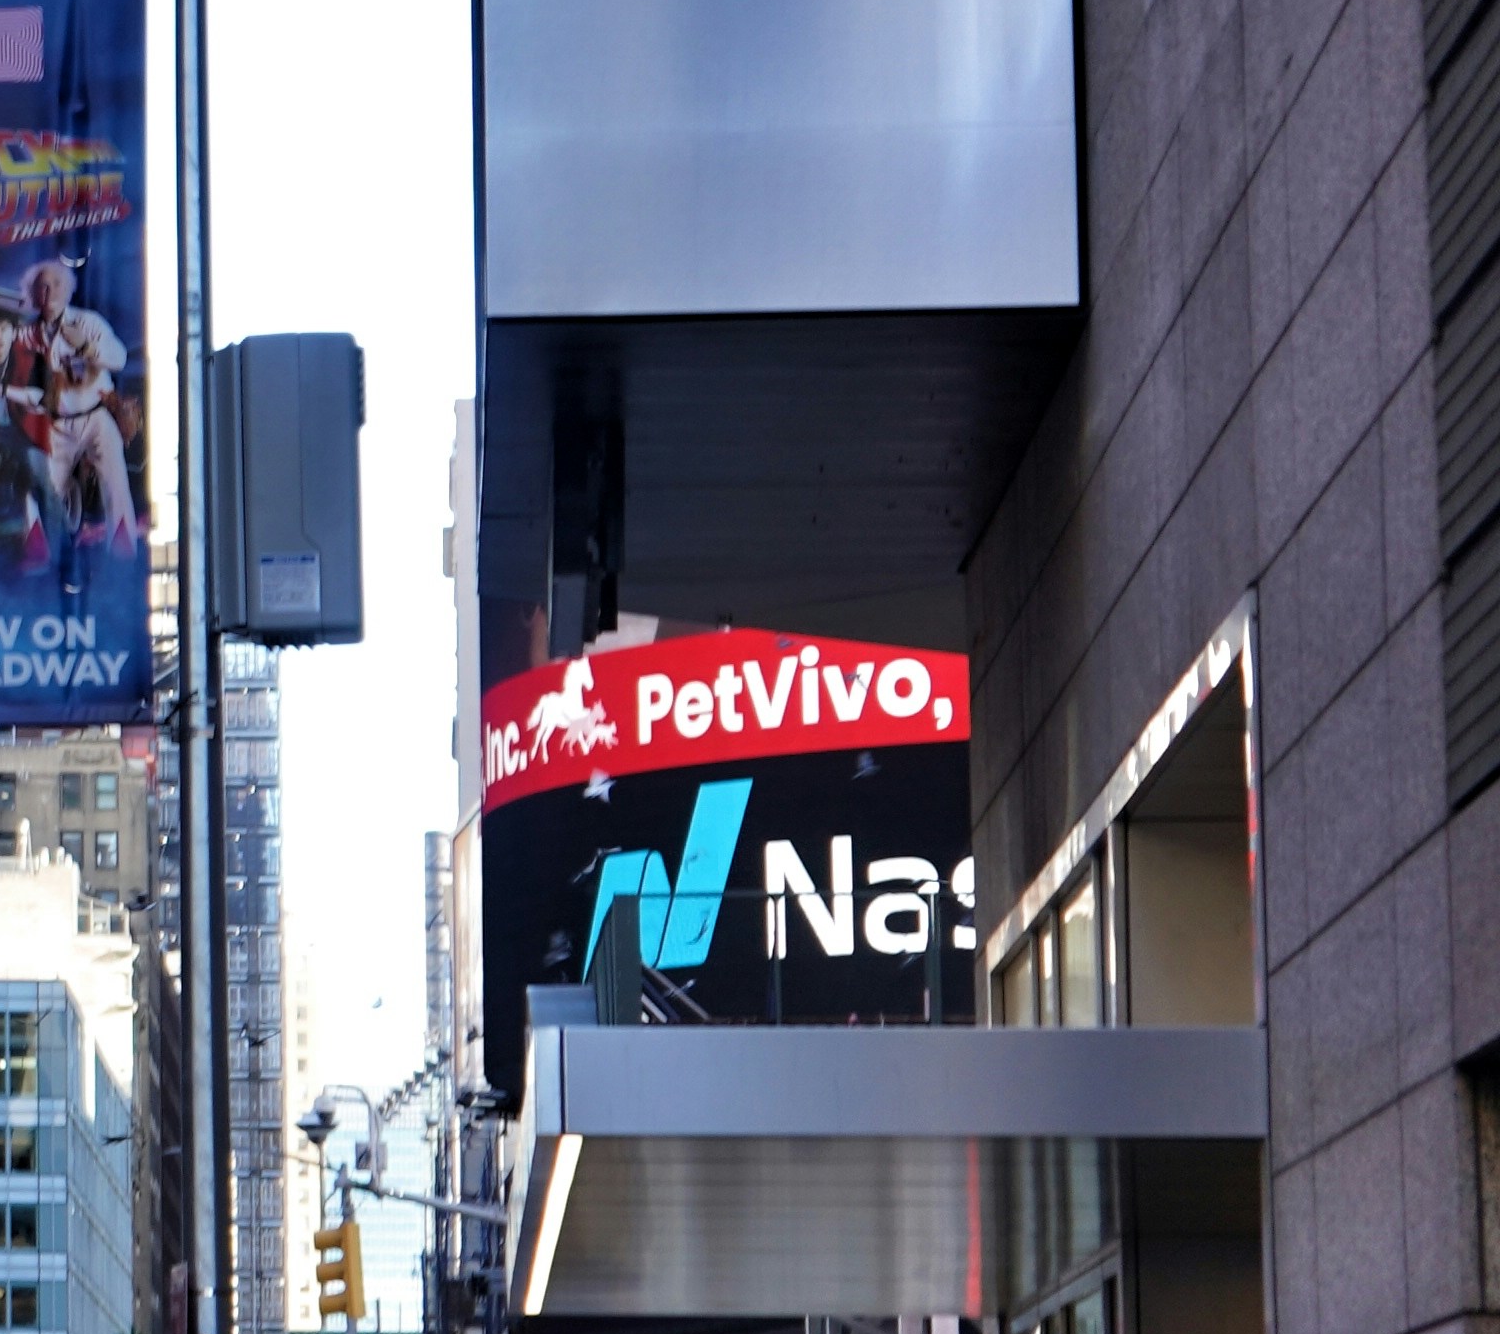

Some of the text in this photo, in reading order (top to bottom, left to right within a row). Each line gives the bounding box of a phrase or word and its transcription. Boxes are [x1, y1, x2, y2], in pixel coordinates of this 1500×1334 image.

[11, 204, 120, 243] THE MUSICAL
[32, 613, 98, 649] ON
[636, 644, 954, 746] PetVivo,
[485, 722, 528, 781] Inc.
